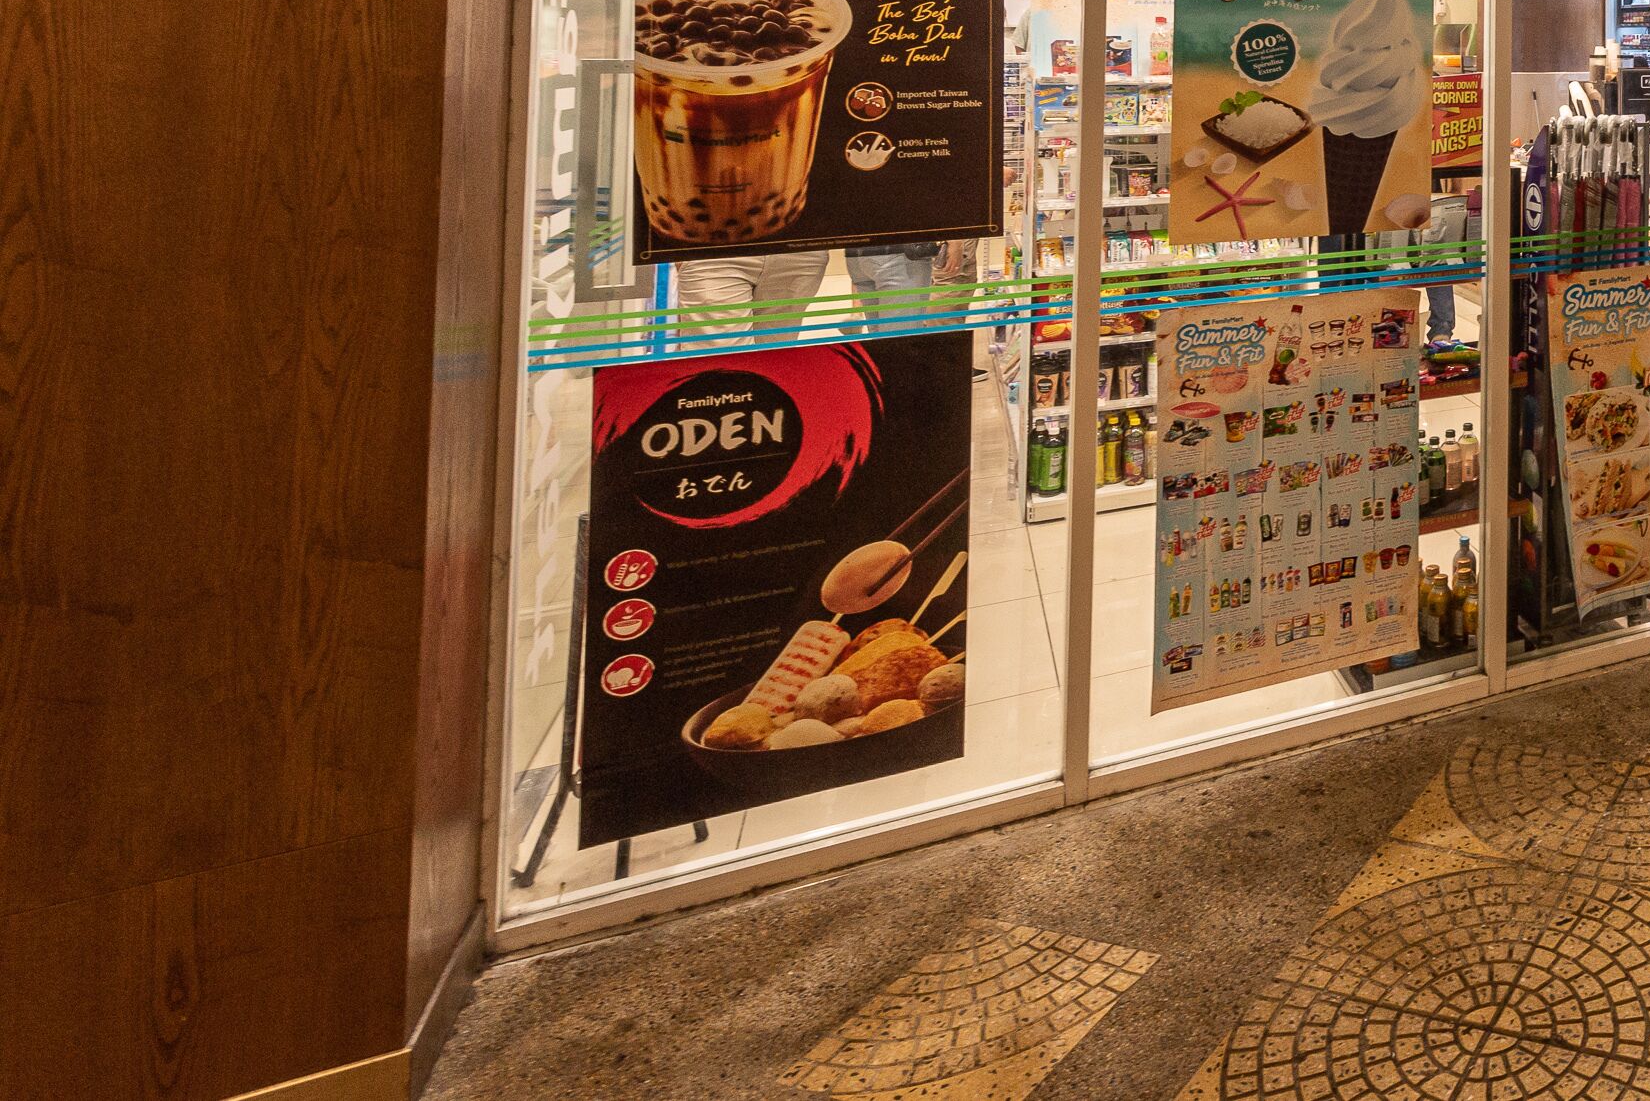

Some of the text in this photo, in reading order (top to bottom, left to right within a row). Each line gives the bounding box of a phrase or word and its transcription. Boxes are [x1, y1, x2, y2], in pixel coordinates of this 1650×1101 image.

[877, 1, 955, 23] The Best
[867, 23, 964, 45] Boba Deal
[1242, 33, 1287, 53] 100%
[880, 45, 950, 67] in Town!
[1252, 59, 1284, 70] Spirulina
[1258, 66, 1282, 76] Extract
[1432, 80, 1478, 90] MARK DOWN
[896, 89, 968, 101] Imported Taiwan
[1432, 91, 1478, 104] CORNER
[896, 99, 983, 111] Brown Sugar Bubble
[1440, 115, 1483, 138] GREAT
[898, 138, 949, 147] 100% Fresh
[1432, 134, 1467, 155] INGS
[897, 149, 951, 159] Creamy Milk
[1598, 275, 1631, 285] FamilyMart
[1211, 316, 1244, 325] FamilyMart
[1565, 319, 1602, 344] Fun
[1605, 311, 1619, 332] &
[1178, 324, 1265, 351] Summer
[1179, 345, 1263, 375] Fun & Fit
[677, 391, 753, 410] FamilyMart
[640, 409, 785, 459] ODEN
[675, 471, 753, 500] おでん
